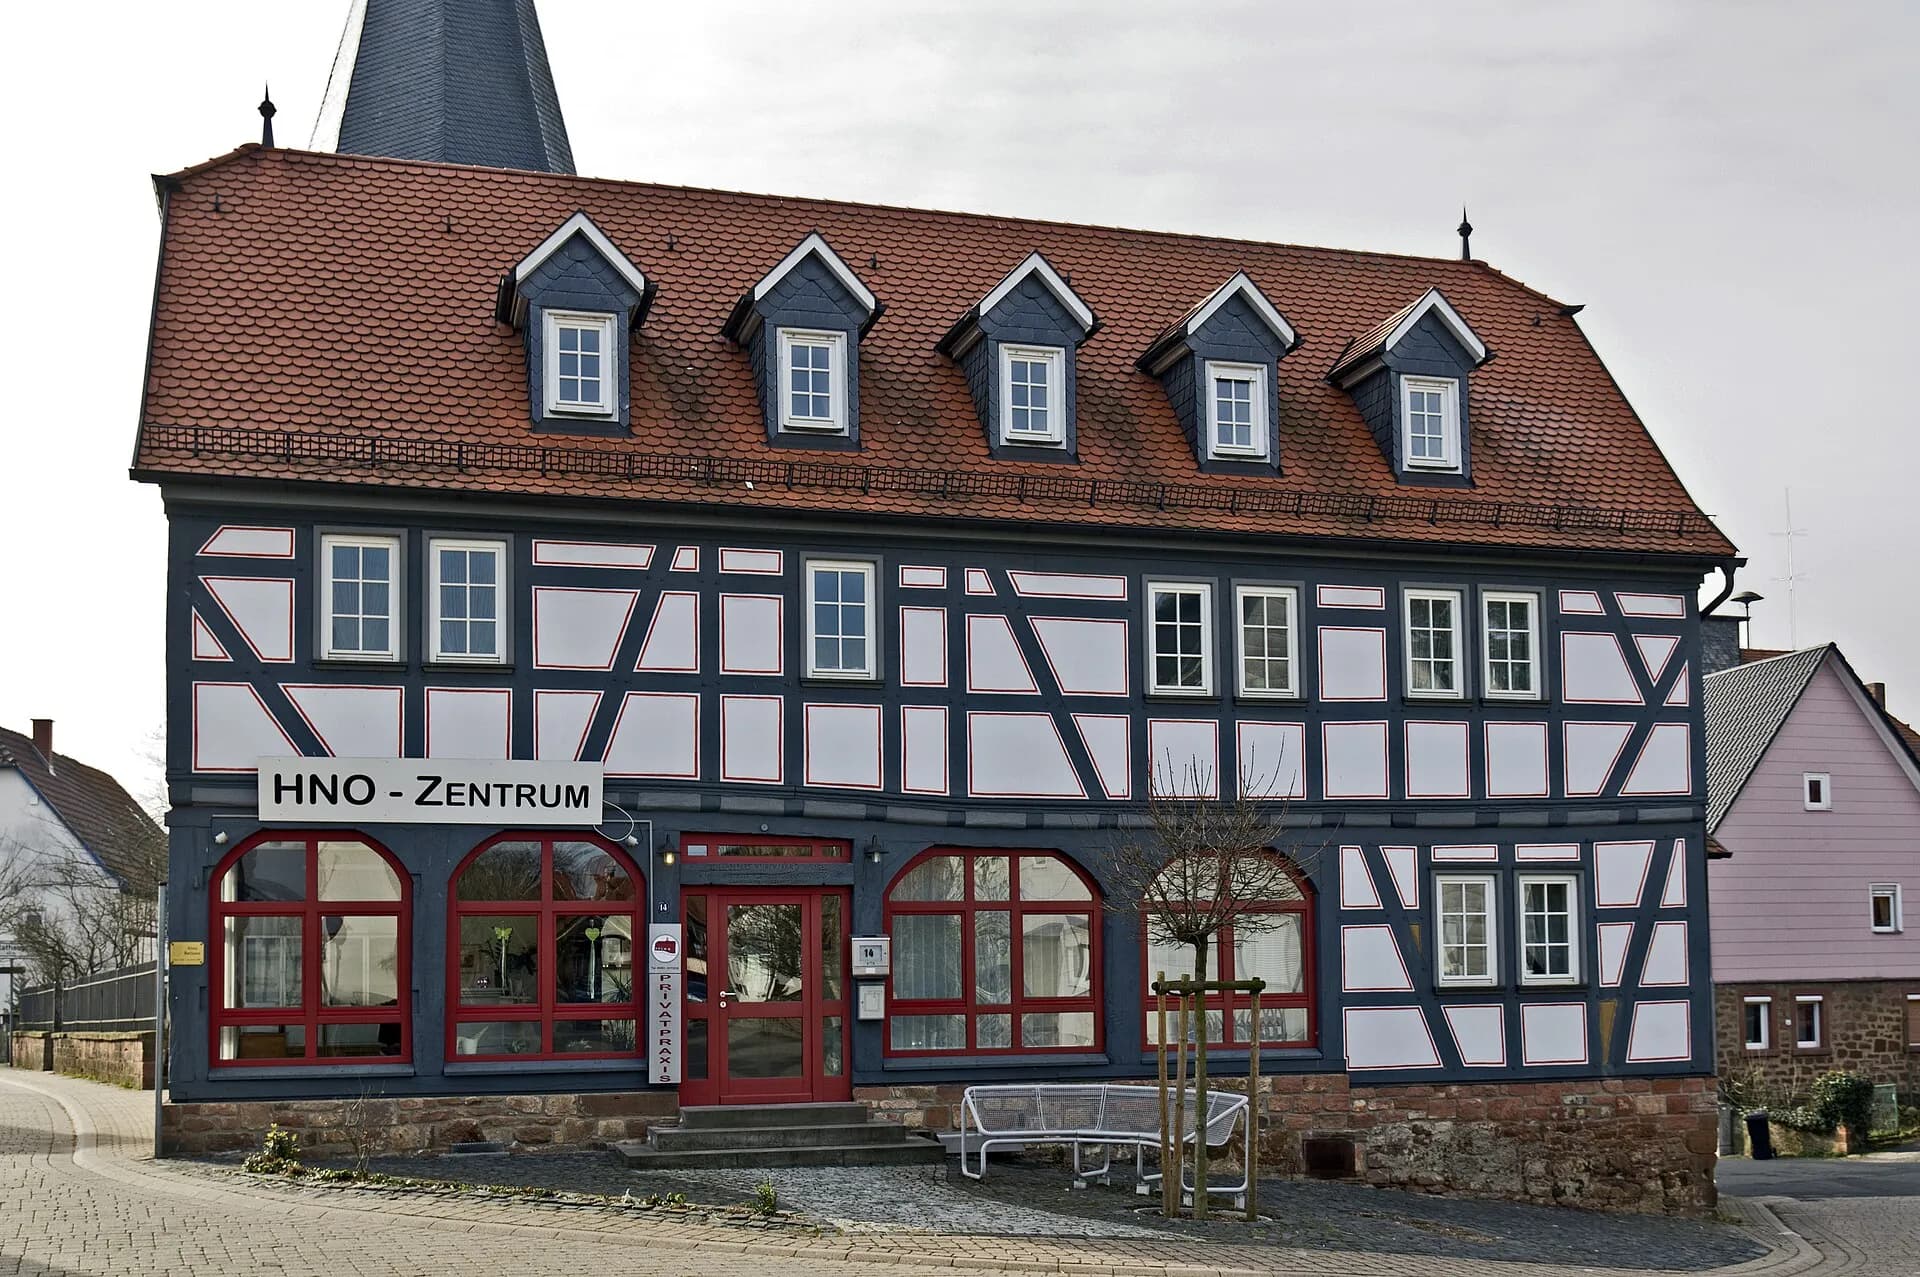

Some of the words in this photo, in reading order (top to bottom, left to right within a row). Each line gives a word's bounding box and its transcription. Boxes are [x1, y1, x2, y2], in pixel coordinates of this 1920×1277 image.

[274, 773, 376, 805] HNO
[660, 903, 668, 912] 14
[659, 974, 672, 1083] PRIVATPRAXIS
